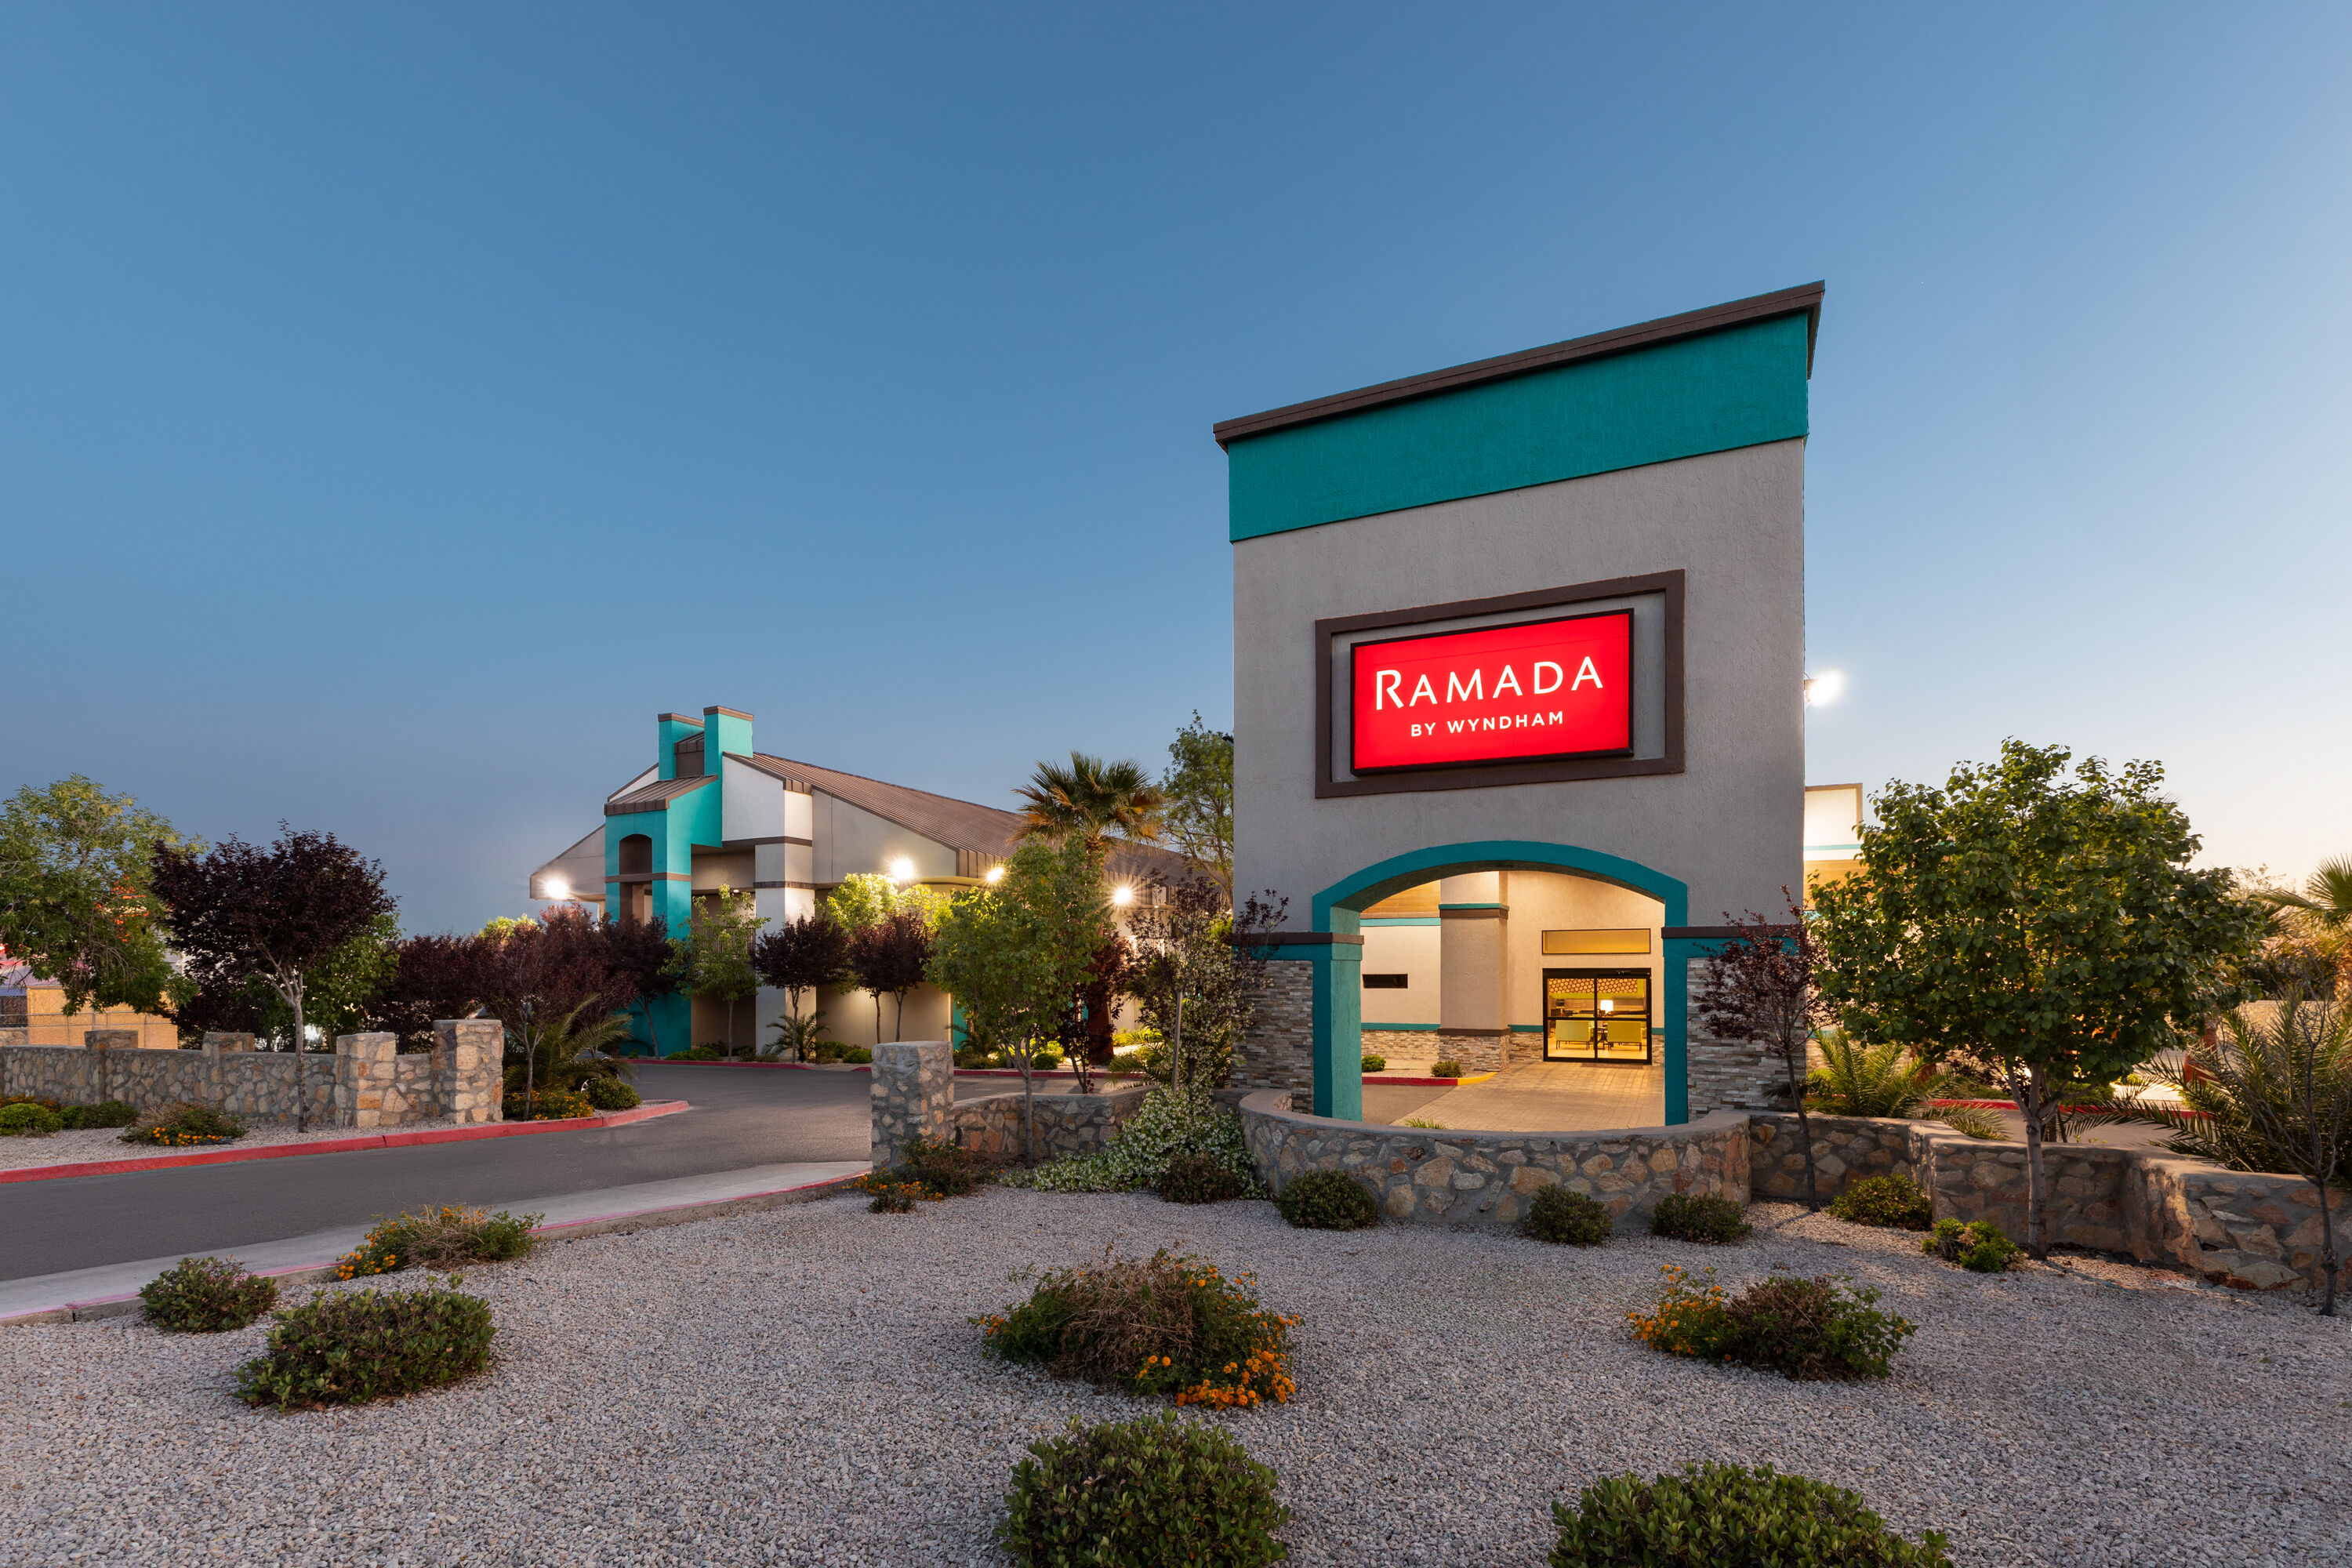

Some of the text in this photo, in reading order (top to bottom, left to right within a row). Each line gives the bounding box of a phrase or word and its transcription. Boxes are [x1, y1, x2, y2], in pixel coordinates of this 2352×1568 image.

[1375, 655, 1603, 711] RAMADA
[1410, 710, 1563, 737] BY WYNDHAM
